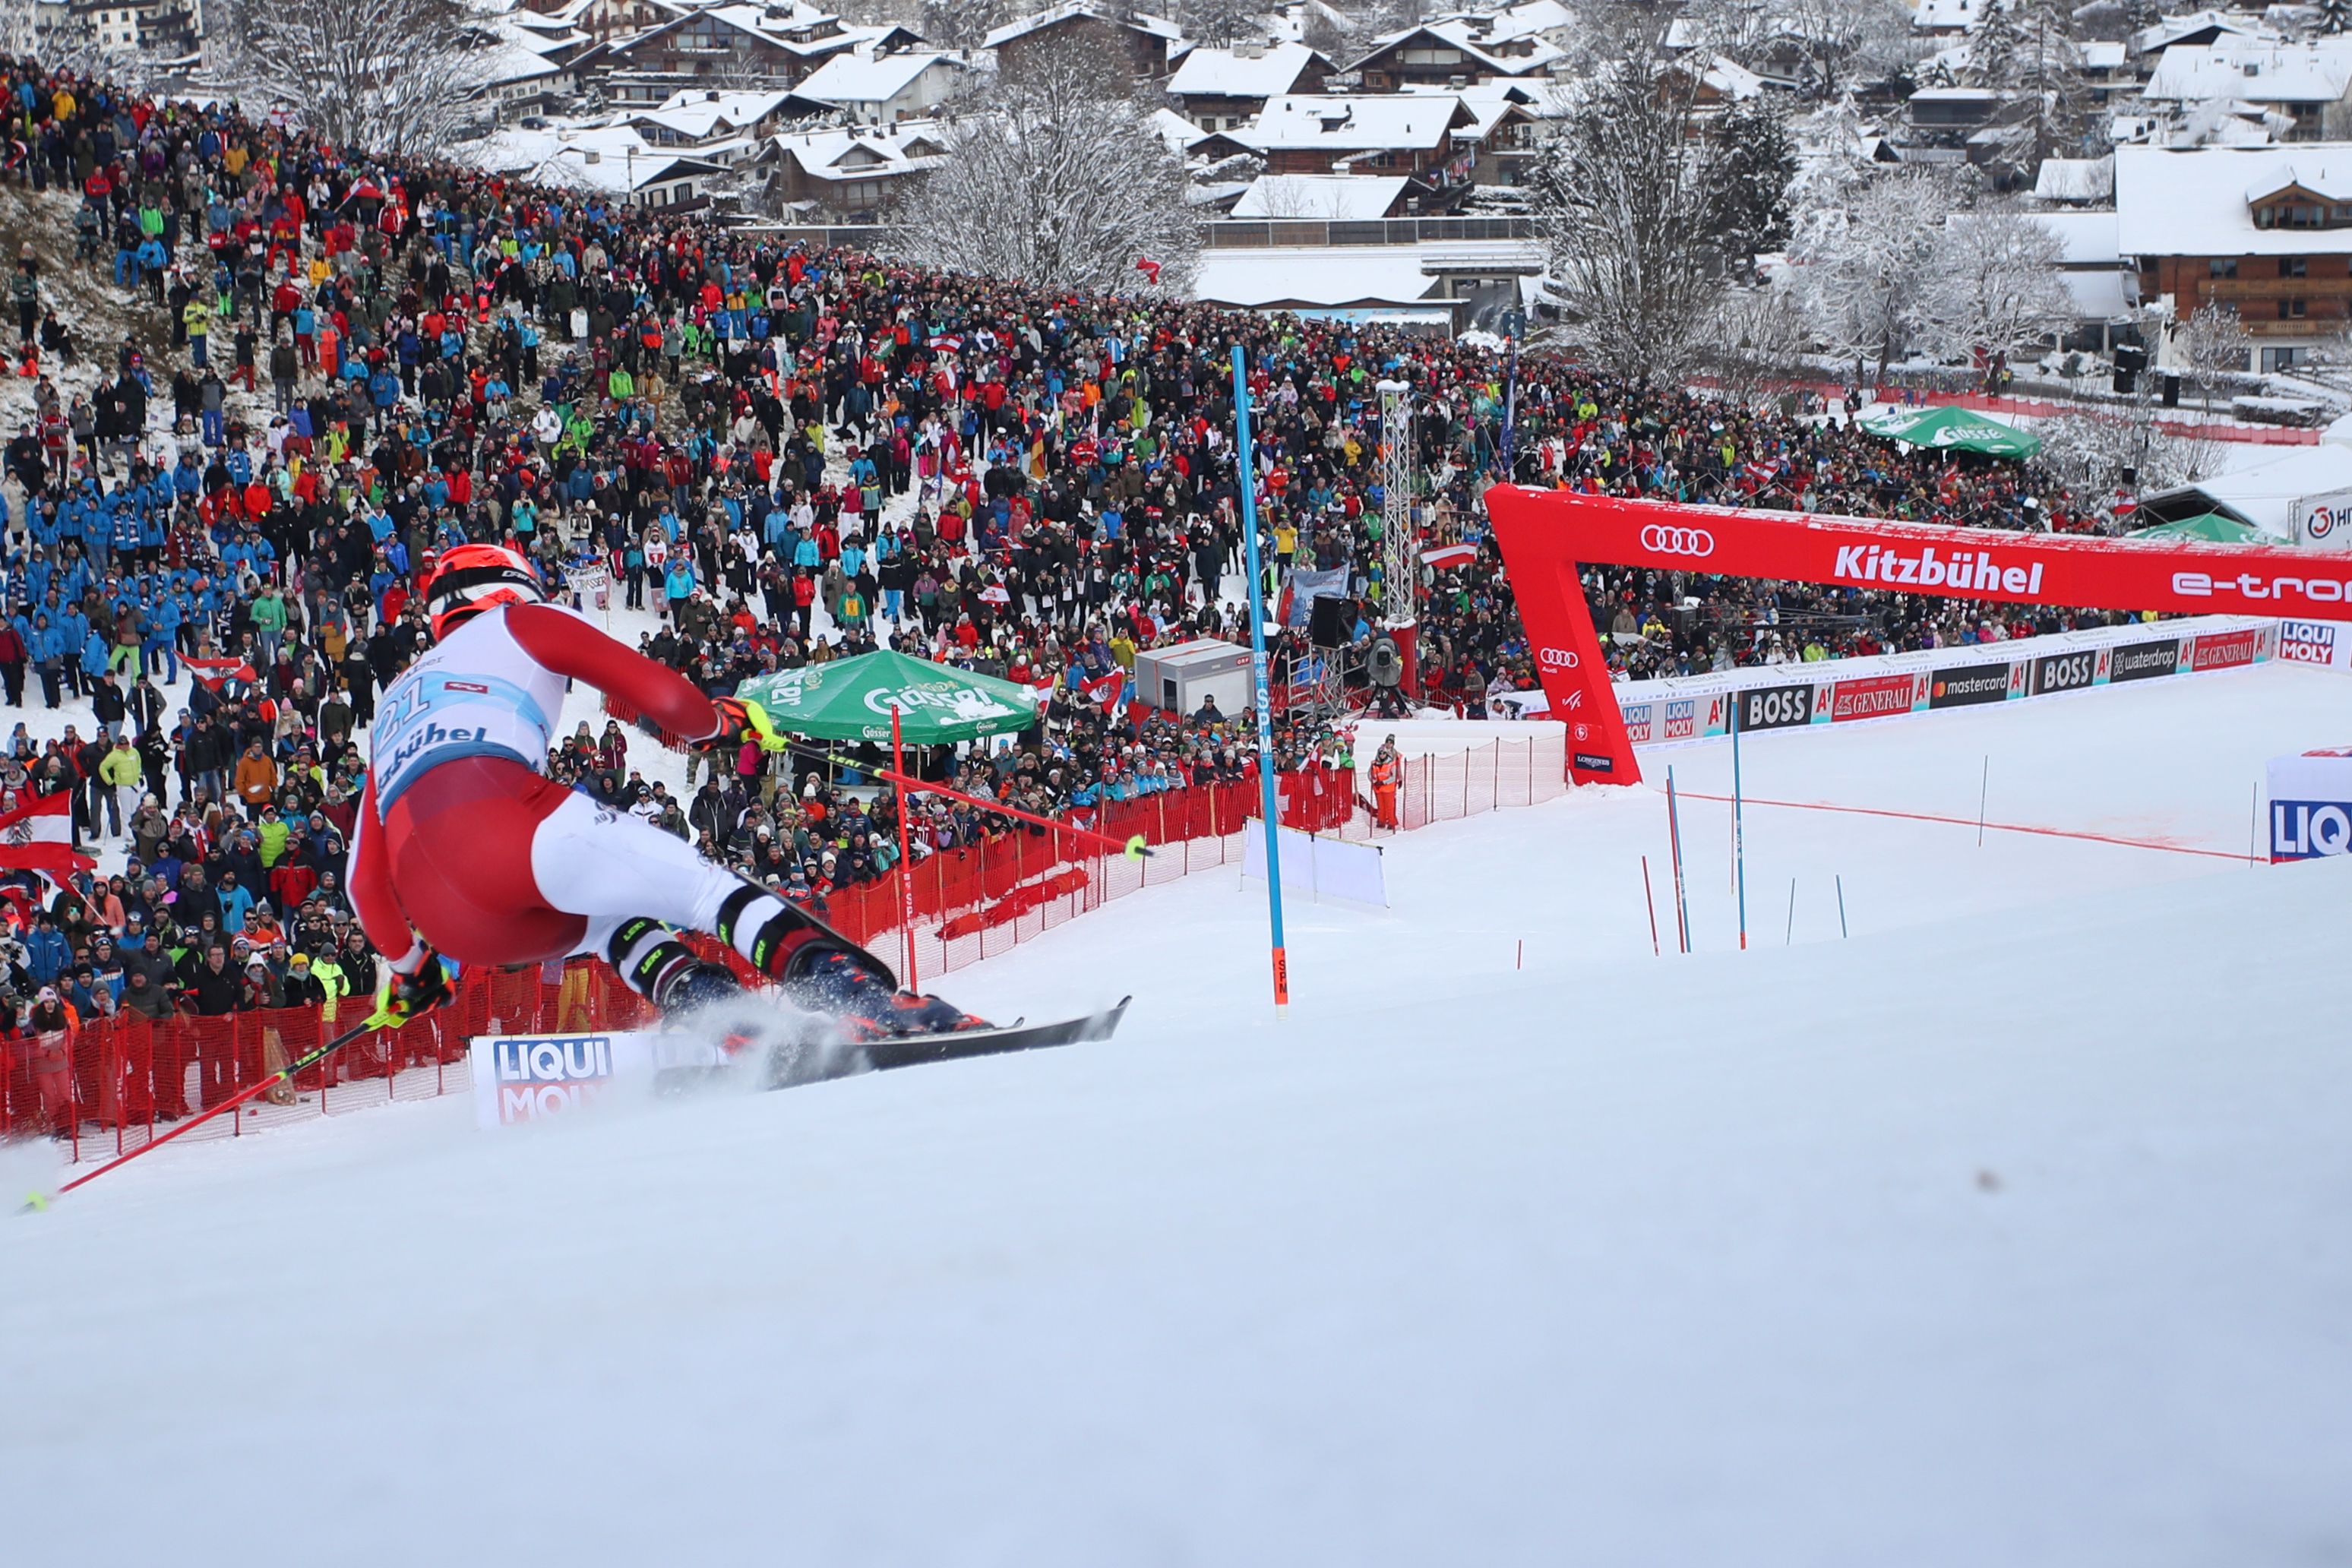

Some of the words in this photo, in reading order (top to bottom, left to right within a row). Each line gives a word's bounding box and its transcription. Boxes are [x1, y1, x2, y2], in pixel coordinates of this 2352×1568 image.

[2337, 506, 2352, 528] HI
[1833, 544, 2044, 595] Kitzbühel
[2172, 572, 2352, 602] e-tro
[2282, 621, 2332, 643] LIQUI
[2125, 647, 2175, 672] waterdrop
[2208, 642, 2252, 665] GENERALI
[2281, 643, 2332, 665] MOLY
[2044, 656, 2090, 689] BOSS
[1948, 673, 2008, 697] mastercard
[1667, 701, 1694, 719] LIQUI
[1749, 690, 1807, 726] BOSS
[1854, 687, 1911, 713] GENERALI
[375, 677, 431, 752] 21
[862, 726, 891, 738] Gösser
[1666, 719, 1693, 737] MOLY
[1577, 756, 1610, 766] LONGINES
[2275, 805, 2352, 855] LIQ
[623, 921, 645, 941] LEKI
[640, 949, 662, 974] LEKI
[499, 1040, 607, 1081] LIQUI
